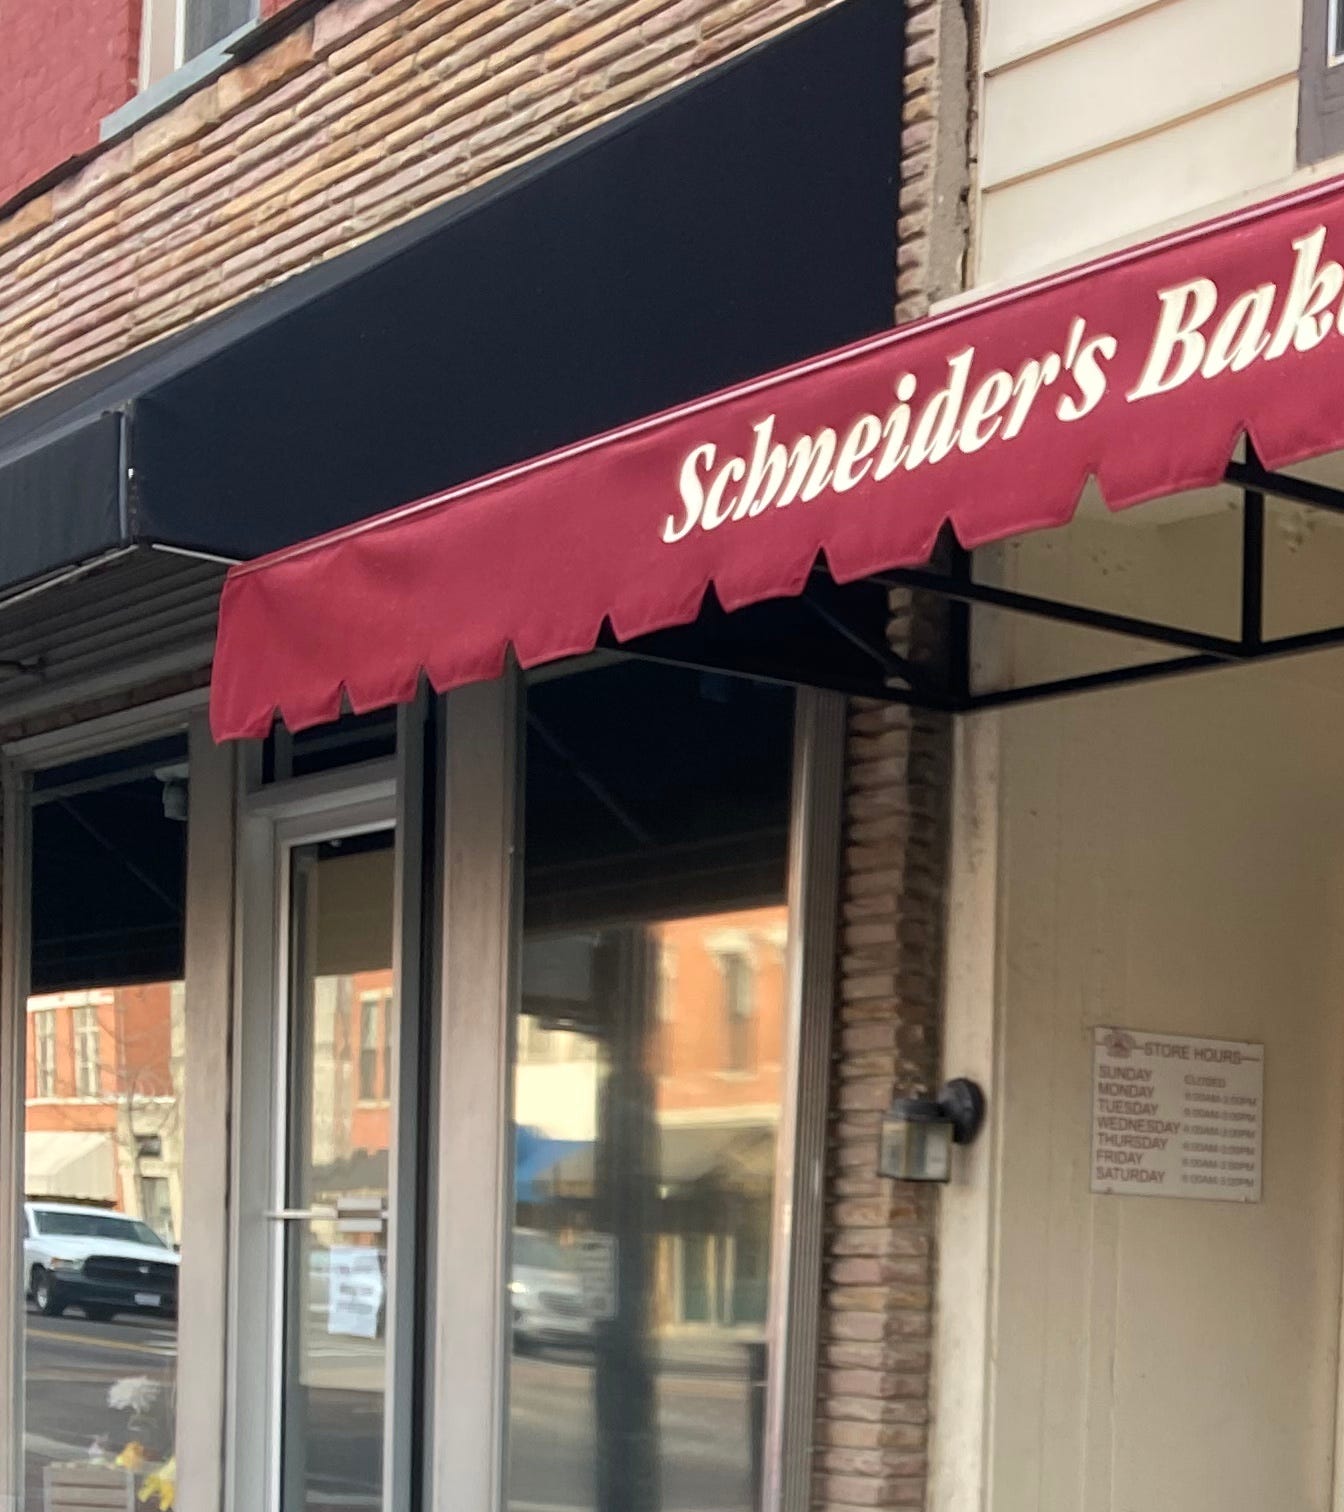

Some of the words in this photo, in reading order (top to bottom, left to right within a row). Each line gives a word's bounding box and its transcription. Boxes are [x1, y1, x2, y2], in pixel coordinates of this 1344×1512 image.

[661, 316, 1119, 545] Schneider's
[1144, 1042, 1189, 1060] STORE
[1194, 1049, 1242, 1065] HOURS
[1098, 1065, 1152, 1081] SUNDAY
[1098, 1082, 1154, 1098] MONDAY
[1098, 1098, 1159, 1115] TUESDAY
[1097, 1117, 1180, 1134] WEDNESDAY
[1097, 1132, 1168, 1150] THURSDAY
[1096, 1150, 1144, 1164] FRIDAY
[1096, 1166, 1165, 1183] SATURDAY
